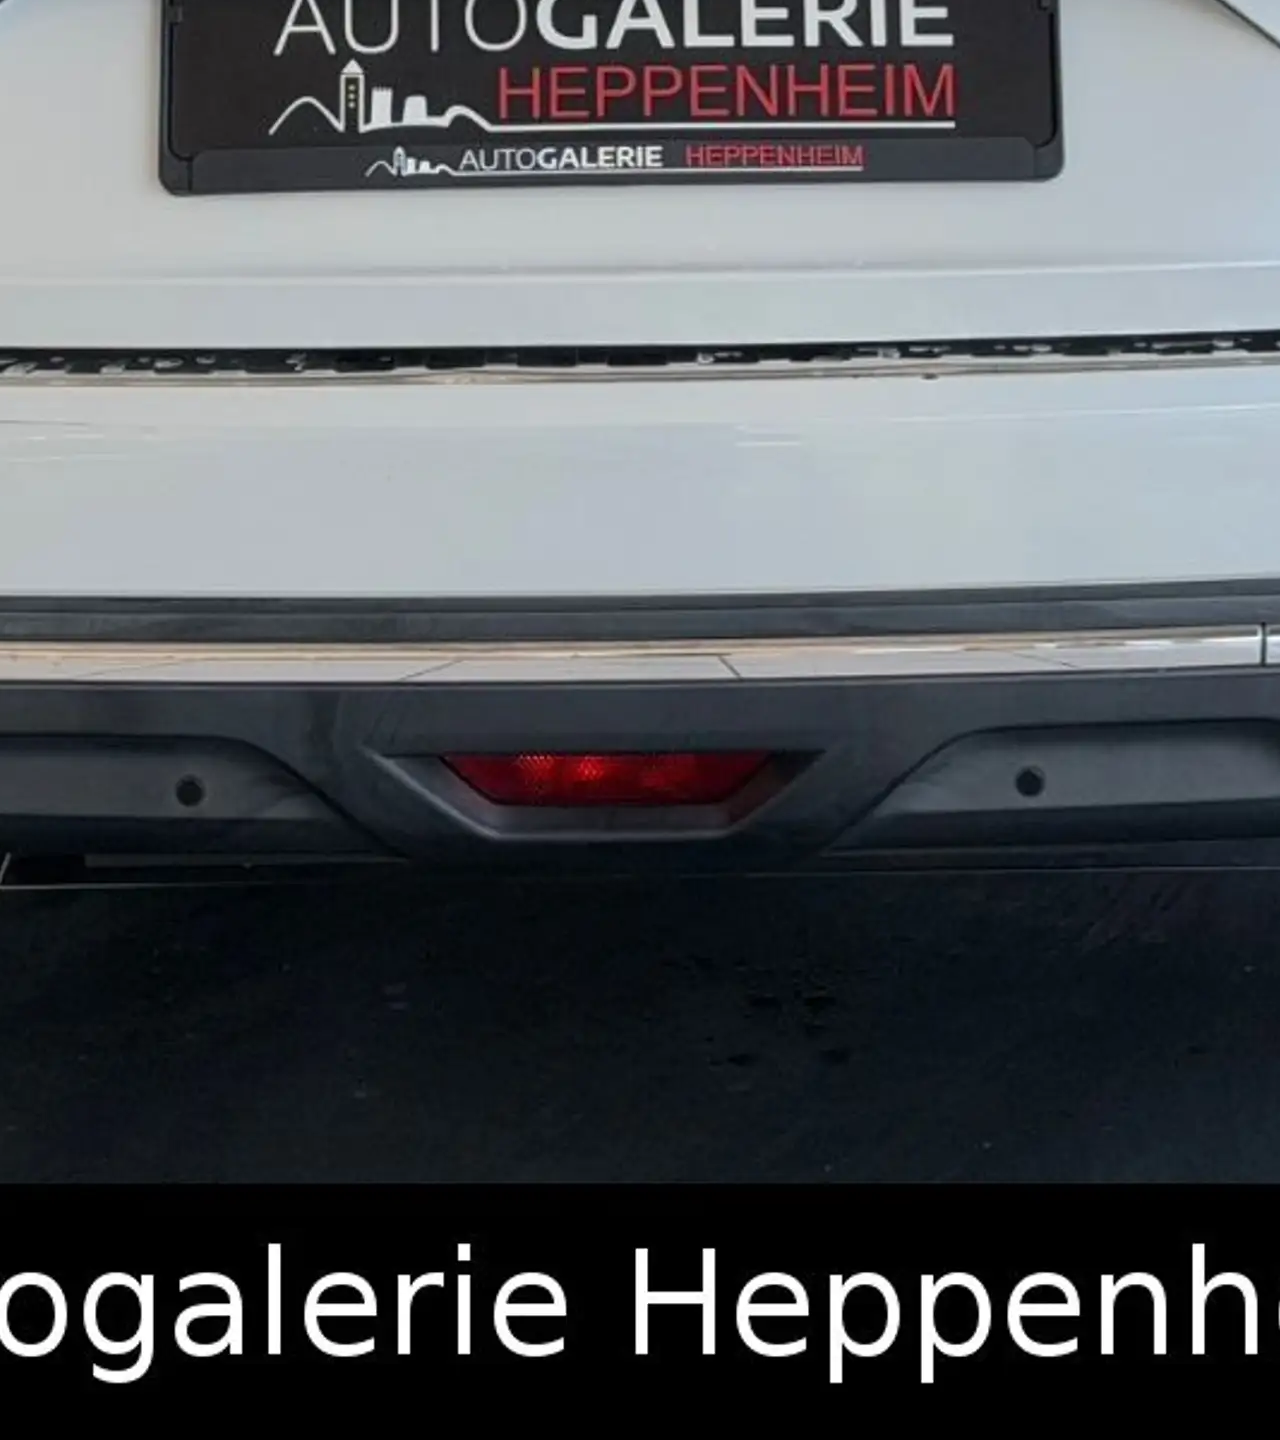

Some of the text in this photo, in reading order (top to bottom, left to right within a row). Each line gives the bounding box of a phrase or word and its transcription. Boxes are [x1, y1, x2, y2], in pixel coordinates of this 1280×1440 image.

[498, 62, 957, 120] HEPPENHEIM
[459, 144, 864, 170] AUTOGALERIE HEPPENHEIM
